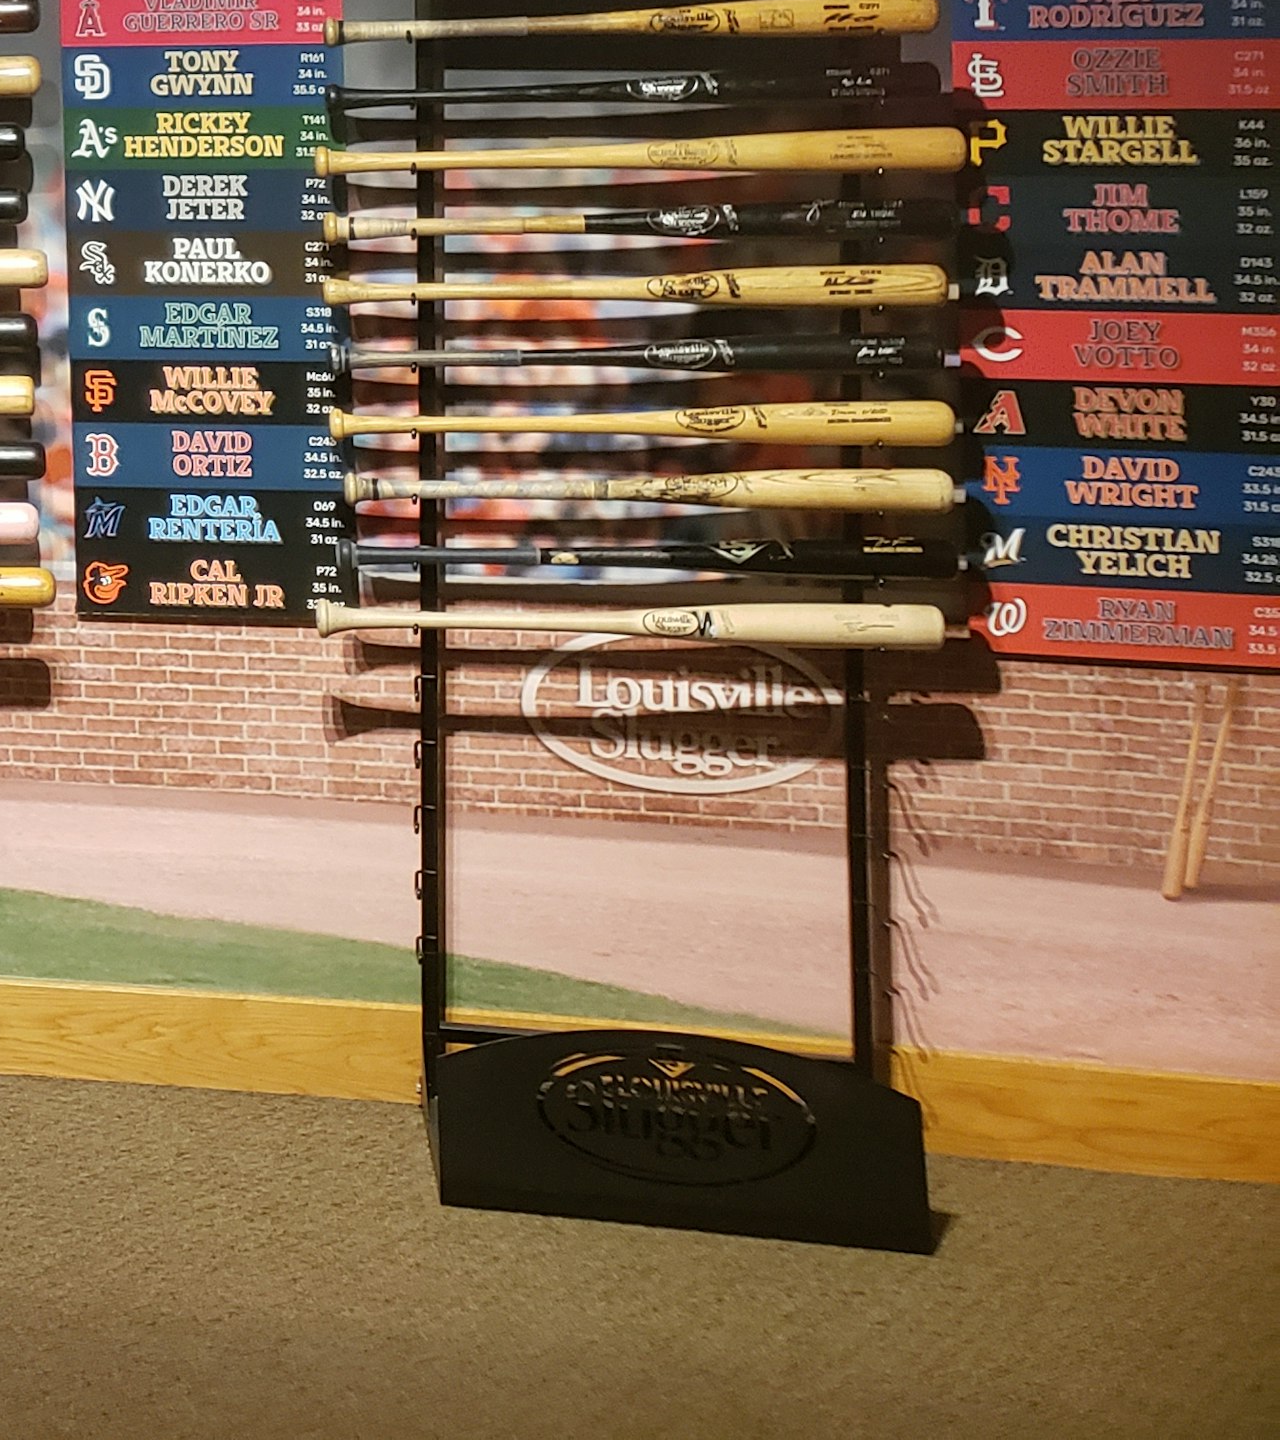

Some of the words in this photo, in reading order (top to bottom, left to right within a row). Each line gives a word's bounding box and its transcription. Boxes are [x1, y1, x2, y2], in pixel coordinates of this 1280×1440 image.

[123, 12, 244, 32] GUERRERO
[249, 12, 279, 31] SR
[164, 50, 239, 72] TONY
[300, 53, 325, 63] R161
[1072, 48, 1160, 71] OZZIE
[150, 73, 254, 96] GWYNN
[1066, 73, 1168, 96] SMITH
[156, 112, 252, 134] RICKEY
[302, 115, 326, 125] T141
[1062, 116, 1176, 139] WILLIE
[123, 135, 284, 157] HENDERSON
[1043, 140, 1199, 164] STARGELL
[162, 175, 249, 197] DEREK
[306, 178, 326, 189] P72
[301, 194, 315, 205] 34
[1092, 183, 1148, 208] JIM
[166, 198, 245, 221] JETER
[1063, 208, 1181, 233] THOME
[172, 237, 241, 260] PAUL
[144, 261, 271, 284] KONERKO
[1079, 250, 1166, 275] ALAN
[1035, 275, 1216, 302] TRAMMELL
[165, 302, 252, 325] EDGAR
[306, 307, 332, 317] S318
[1090, 320, 1161, 343] JOEY
[1074, 344, 1180, 369] VOTTO
[163, 366, 259, 389] WILLIE
[150, 390, 276, 415] McCOVEY
[1072, 386, 1184, 412] DEVON
[1073, 412, 1187, 441] WHITE
[171, 430, 252, 453] DAVID
[173, 454, 253, 477] ORTIZ
[1081, 455, 1180, 482] DAVID
[170, 494, 257, 517] EDGAR
[1065, 480, 1199, 508] WRIGHT
[148, 513, 283, 544] RENTERÍA
[1047, 523, 1221, 554] CHRISTIAN
[190, 559, 241, 582] CAL
[316, 566, 337, 577] P72
[1076, 550, 1192, 579] YELICH
[149, 582, 246, 607] RIPKEN
[253, 584, 284, 608] JR
[312, 583, 328, 593] 35
[1098, 598, 1176, 622] RYAN
[1043, 619, 1234, 649] ZIMMERMAN
[577, 658, 808, 718] Louisville
[590, 708, 779, 776] Slugger
